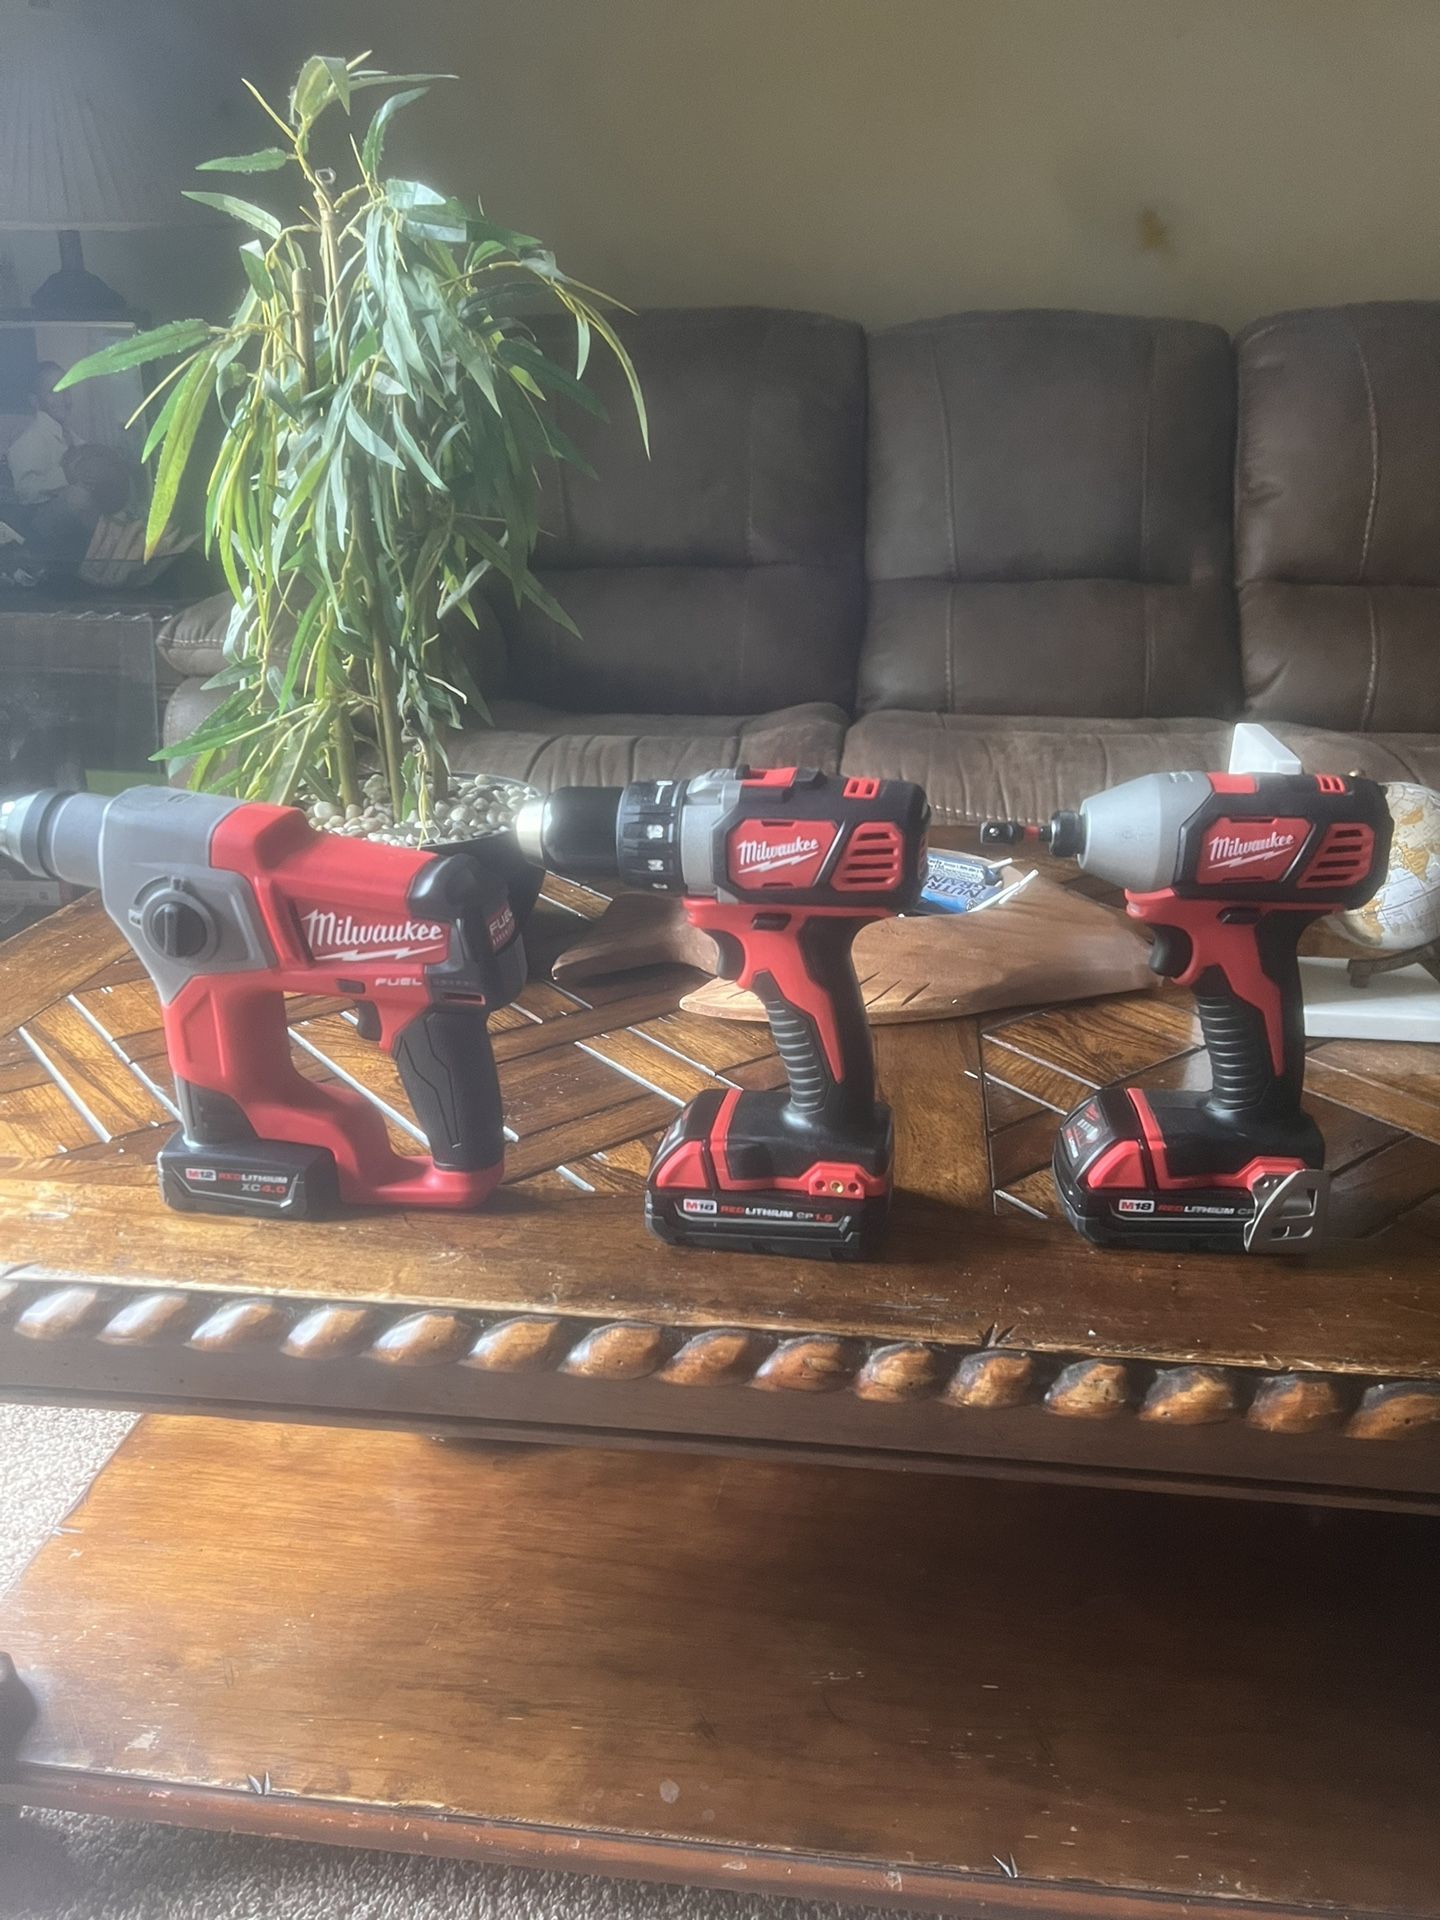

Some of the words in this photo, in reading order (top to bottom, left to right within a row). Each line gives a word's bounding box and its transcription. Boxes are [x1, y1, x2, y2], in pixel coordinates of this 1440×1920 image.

[736, 836, 819, 865] Milwaukee
[1208, 831, 1294, 861] Milwaukee
[301, 909, 444, 948] Milwaukee
[375, 977, 423, 986] FUEL
[187, 1169, 215, 1180] M12
[686, 1200, 715, 1212] M18
[1121, 1201, 1153, 1211] M18
